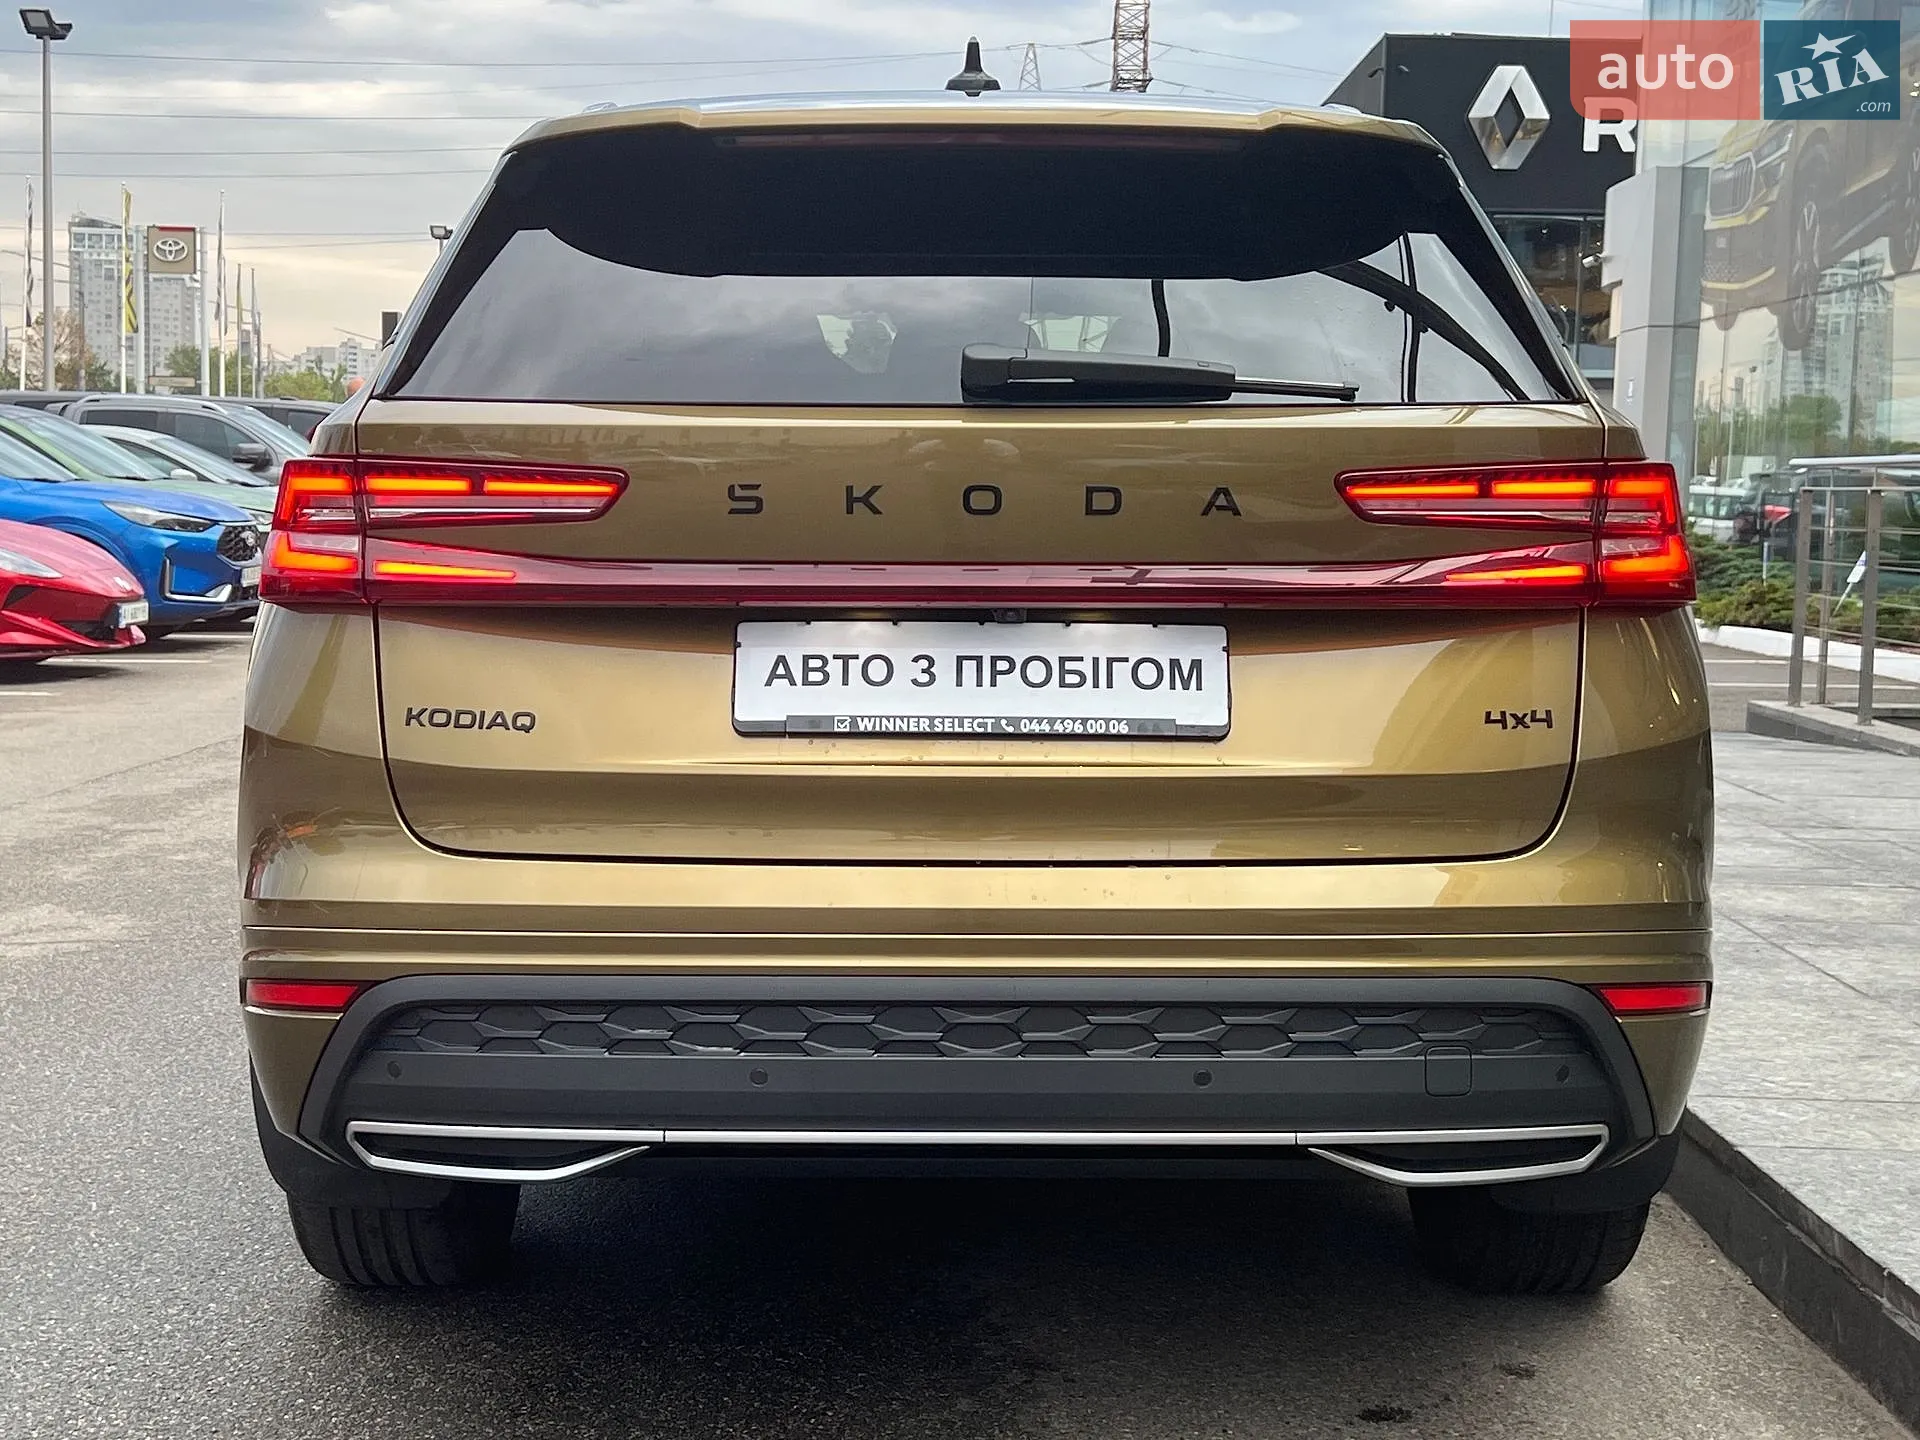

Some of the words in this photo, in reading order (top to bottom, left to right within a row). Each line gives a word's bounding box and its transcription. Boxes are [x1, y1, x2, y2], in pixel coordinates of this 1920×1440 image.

[727, 483, 1242, 516] SKODA
[764, 654, 895, 688] АВТО
[955, 656, 1204, 691] ПРОБІГОМ
[405, 706, 537, 734] KODIAQ
[856, 717, 930, 732] WINNER
[934, 717, 995, 732] SELECT
[1020, 719, 1050, 733] 044
[1053, 719, 1083, 733] 496
[1086, 719, 1106, 733] 00
[1109, 719, 1129, 733] 06
[1484, 709, 1553, 730] 4x4
